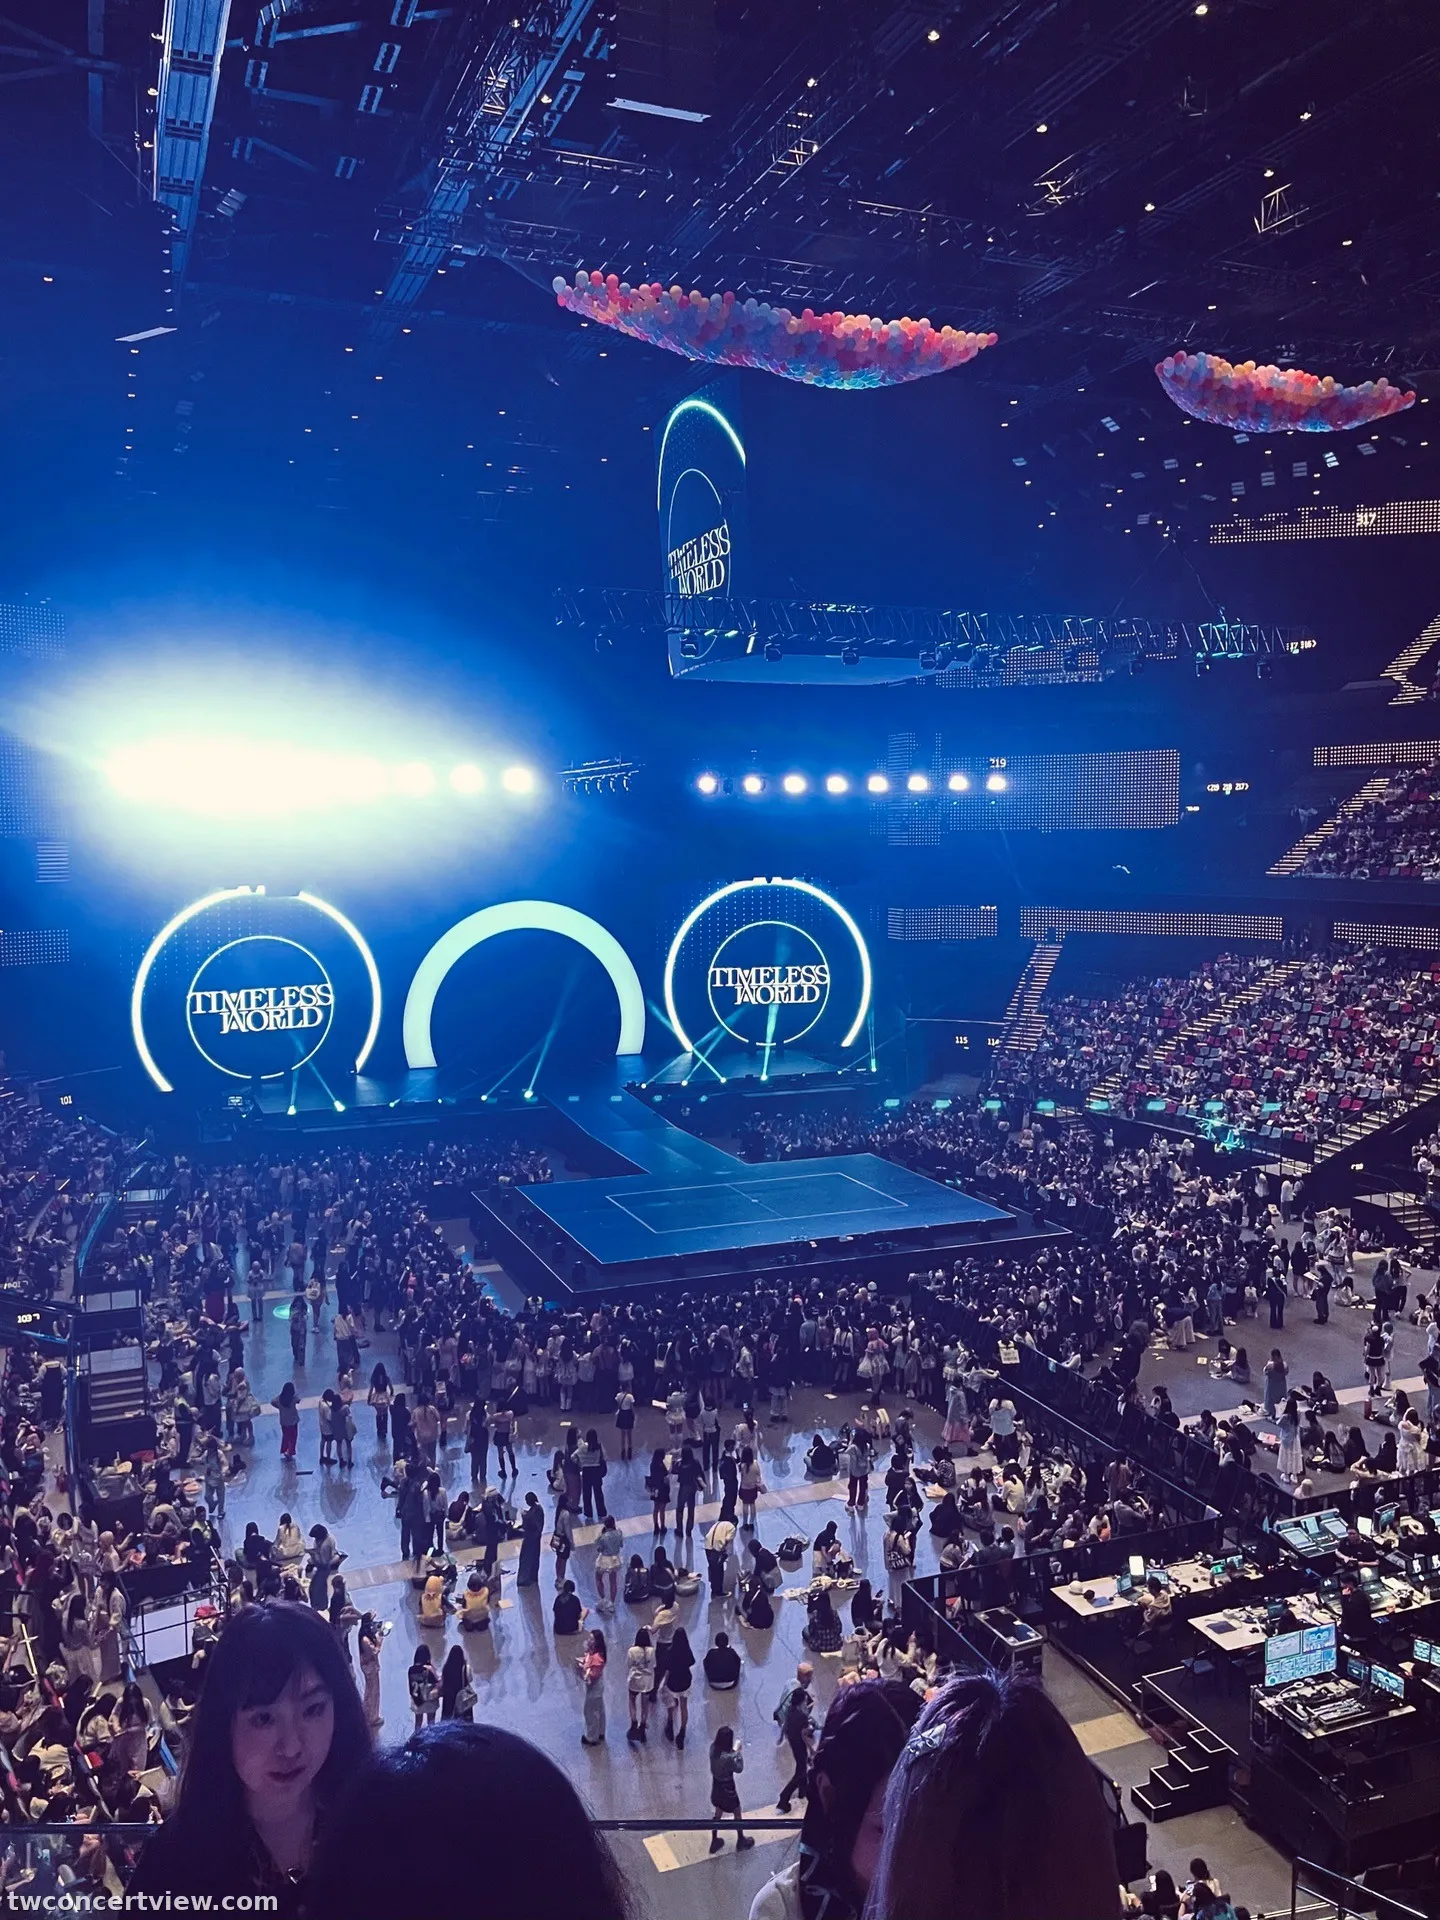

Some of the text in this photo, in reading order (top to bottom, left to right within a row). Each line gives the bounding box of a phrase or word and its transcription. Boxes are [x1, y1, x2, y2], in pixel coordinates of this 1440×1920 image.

[1356, 512, 1377, 527] 317
[668, 525, 730, 579] TIMELESS
[679, 559, 725, 595] WORLD
[709, 965, 829, 987] TIMELESS
[187, 983, 334, 1014] TIMELESS
[734, 984, 820, 1005] WORLD
[219, 1006, 323, 1034] WORLD
[955, 1036, 968, 1045] 115
[60, 1095, 73, 1106] 101
[17, 1314, 33, 1324] 103
